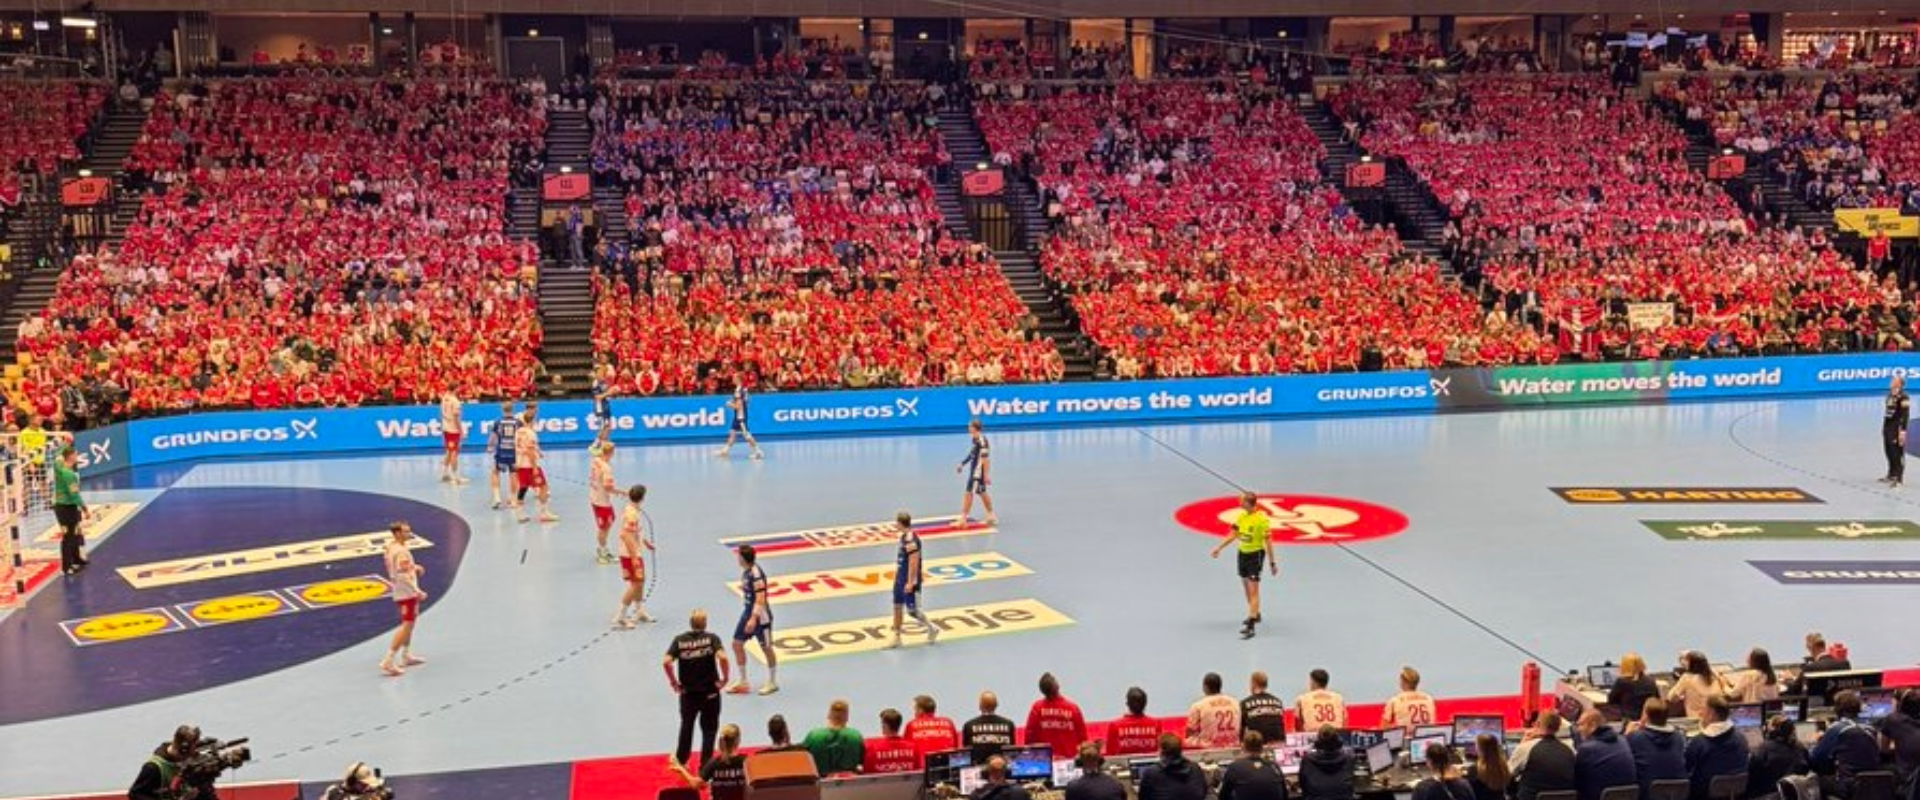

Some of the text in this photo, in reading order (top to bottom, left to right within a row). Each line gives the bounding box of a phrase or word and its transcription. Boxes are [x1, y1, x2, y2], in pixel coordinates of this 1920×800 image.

[1500, 368, 1781, 395] Water moves the world
[1817, 366, 1920, 382] GRUNDFOS
[968, 387, 1272, 416] Water moves the world
[1317, 385, 1427, 402] GRUNDFOS
[376, 418, 473, 439] Watr
[481, 416, 579, 435] ves
[642, 407, 725, 428] world
[773, 405, 895, 423] GRUNDFOS
[152, 427, 290, 450] GRUNDFOS
[738, 558, 1011, 599] trivgo
[773, 606, 1036, 655] gorenje
[1214, 709, 1236, 731] 22
[1313, 703, 1336, 722] 38
[1408, 703, 1431, 724] 26
